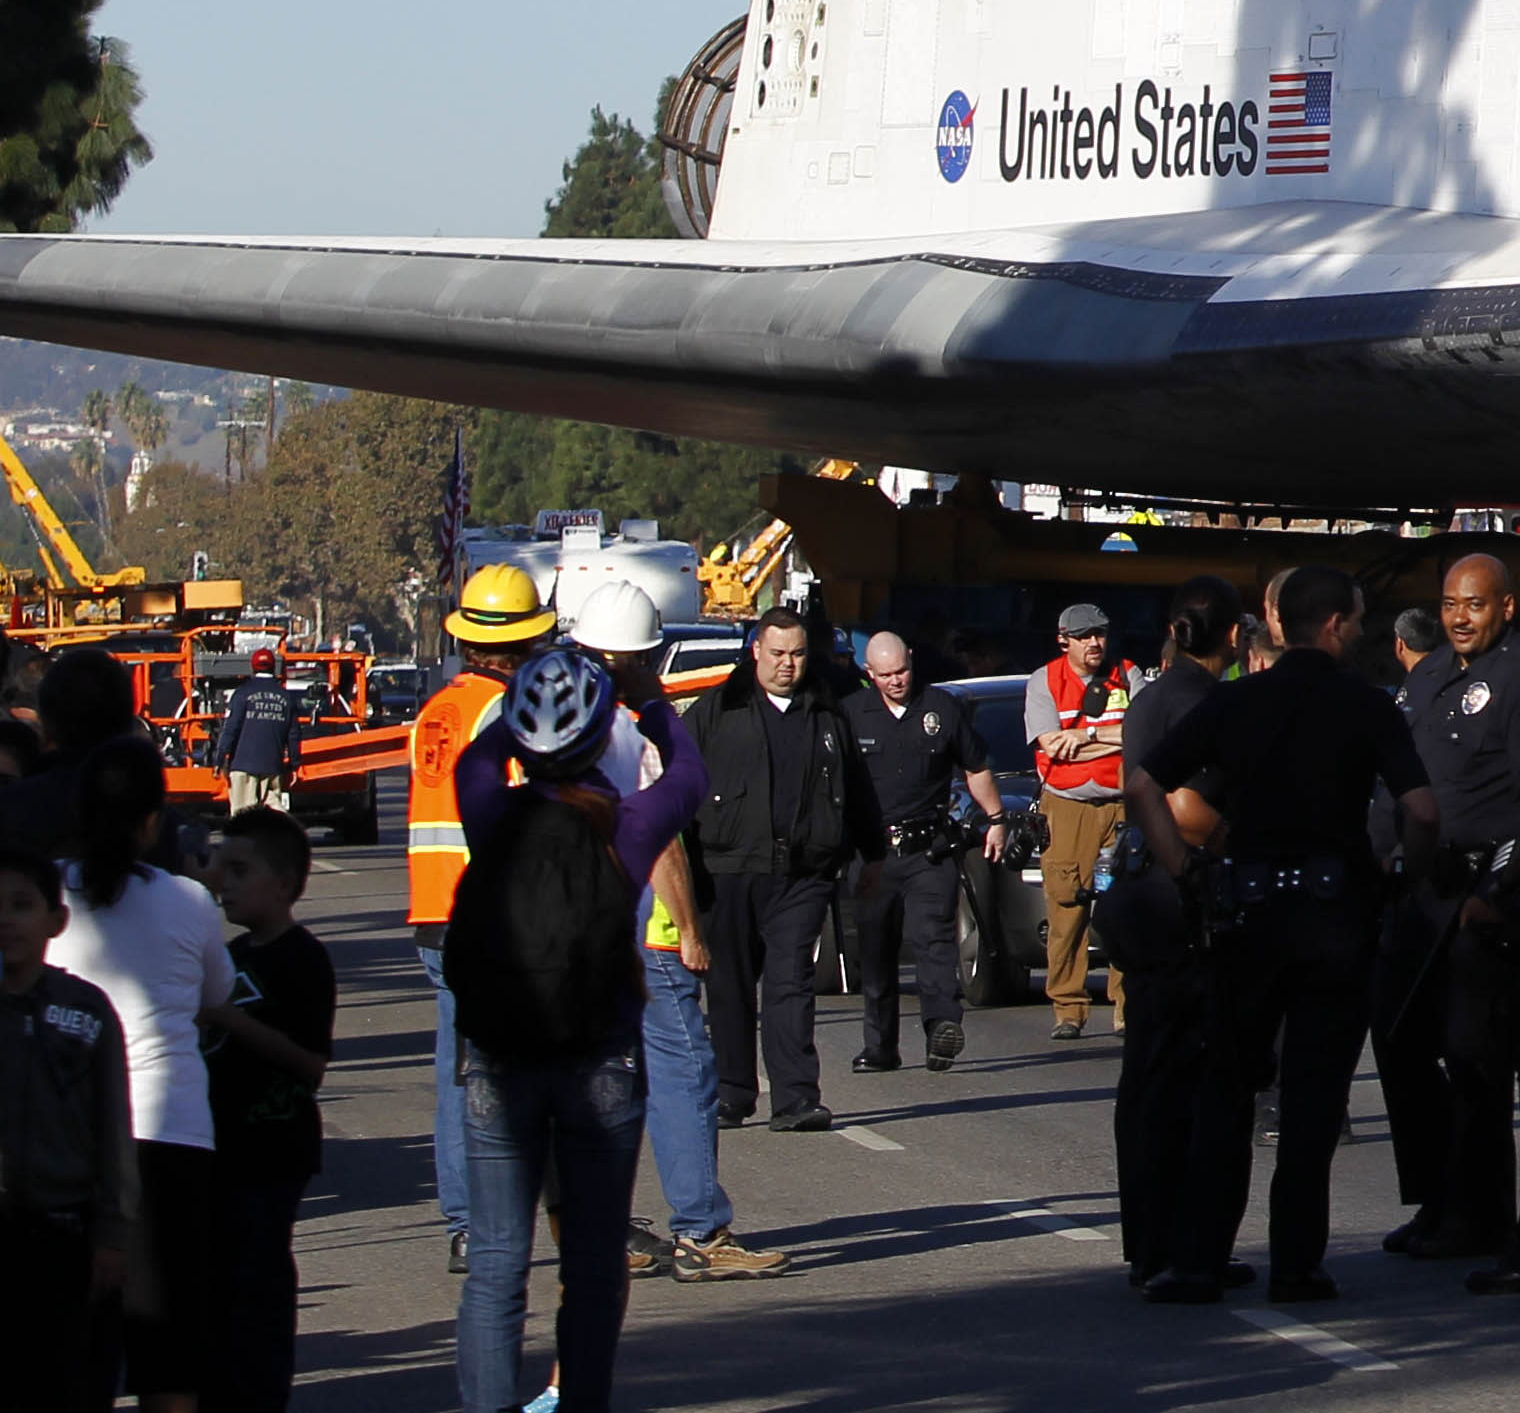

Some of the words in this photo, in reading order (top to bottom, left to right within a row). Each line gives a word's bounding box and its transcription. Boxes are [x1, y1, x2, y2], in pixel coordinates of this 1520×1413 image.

[937, 125, 973, 148] NASA
[999, 82, 1123, 182] United
[1131, 78, 1259, 180] States
